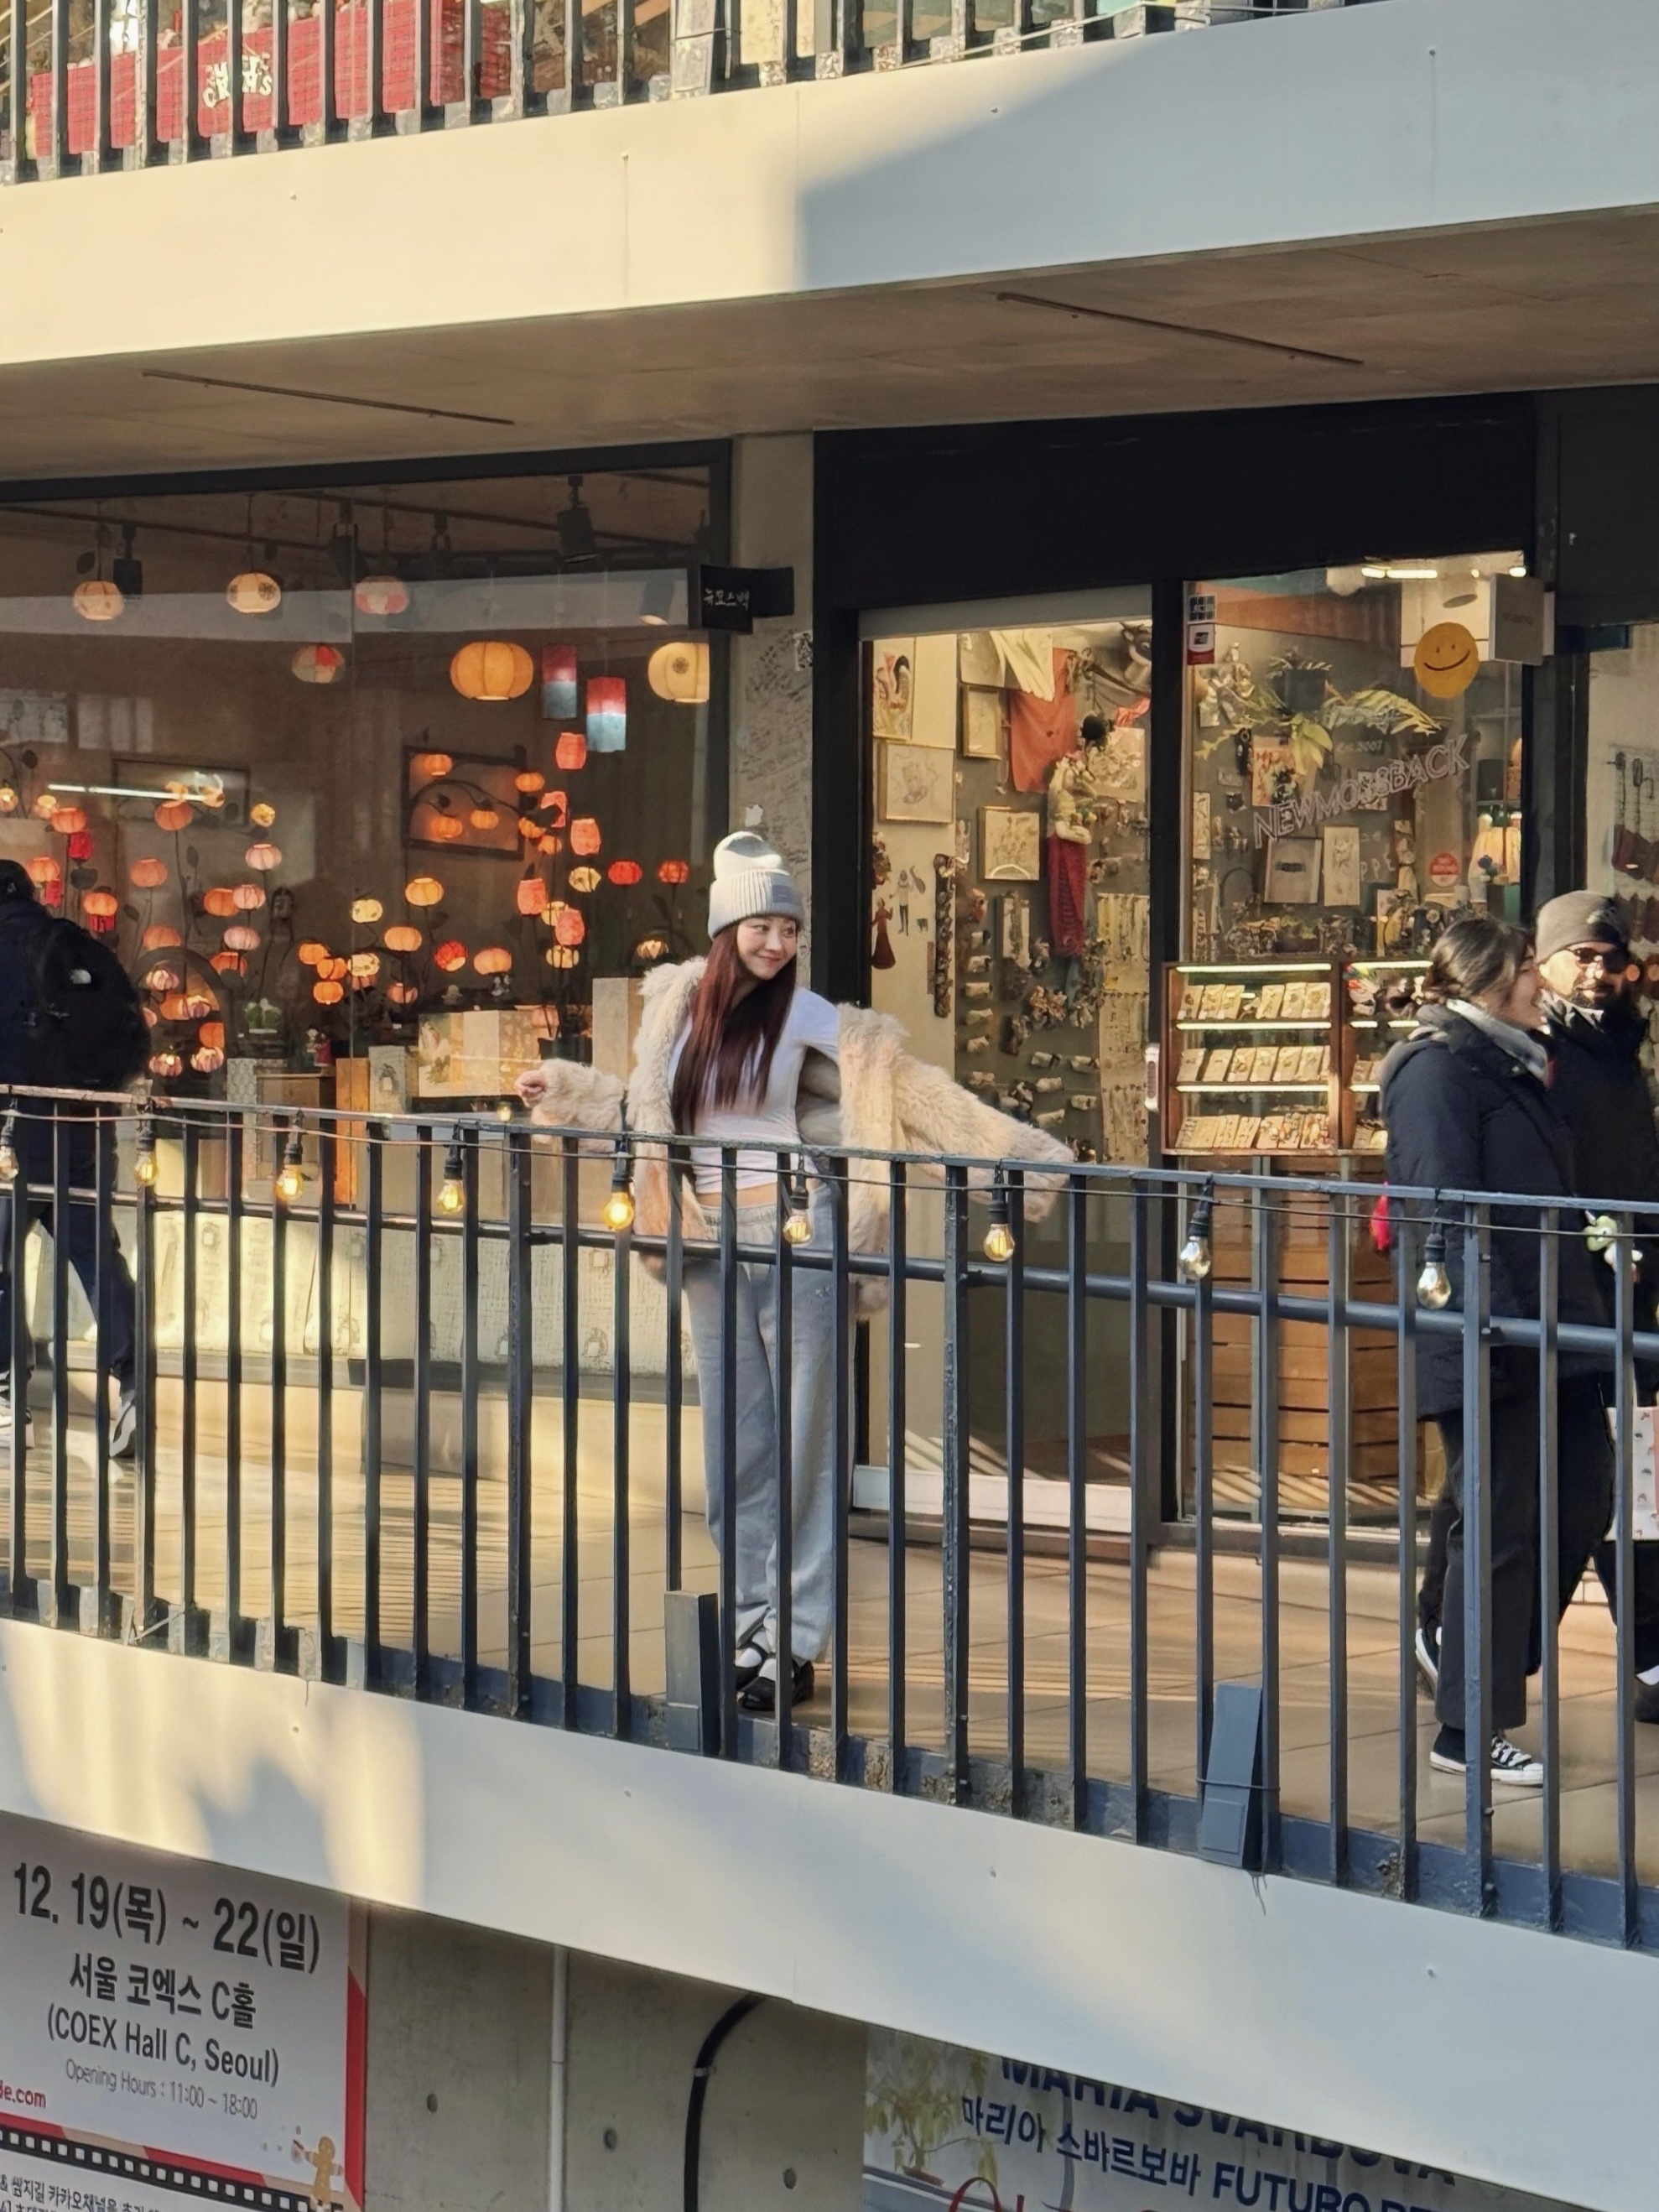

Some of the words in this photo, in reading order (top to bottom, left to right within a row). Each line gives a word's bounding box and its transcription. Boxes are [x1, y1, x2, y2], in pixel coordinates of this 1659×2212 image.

[1253, 733, 1470, 849] NEWMOSSBACK
[14, 1862, 59, 1924] 12.
[71, 1872, 167, 1946] 19(목)
[213, 1897, 320, 1974] 22(일)
[70, 1953, 117, 2001] 서울
[127, 1964, 202, 2016] 코엑스
[212, 1981, 257, 2029] C홀
[48, 2003, 117, 2051] (COEX
[126, 2022, 167, 2061] Hall
[175, 2032, 197, 2071] C,
[205, 2038, 279, 2087] Seoul)
[66, 2058, 117, 2092] Opening
[121, 2070, 156, 2096] Hours
[169, 2081, 205, 2108] 11:00
[223, 2093, 257, 2120] 18:00
[962, 2095, 1046, 2152] 마리아
[1056, 2122, 1202, 2197] 스바르보바
